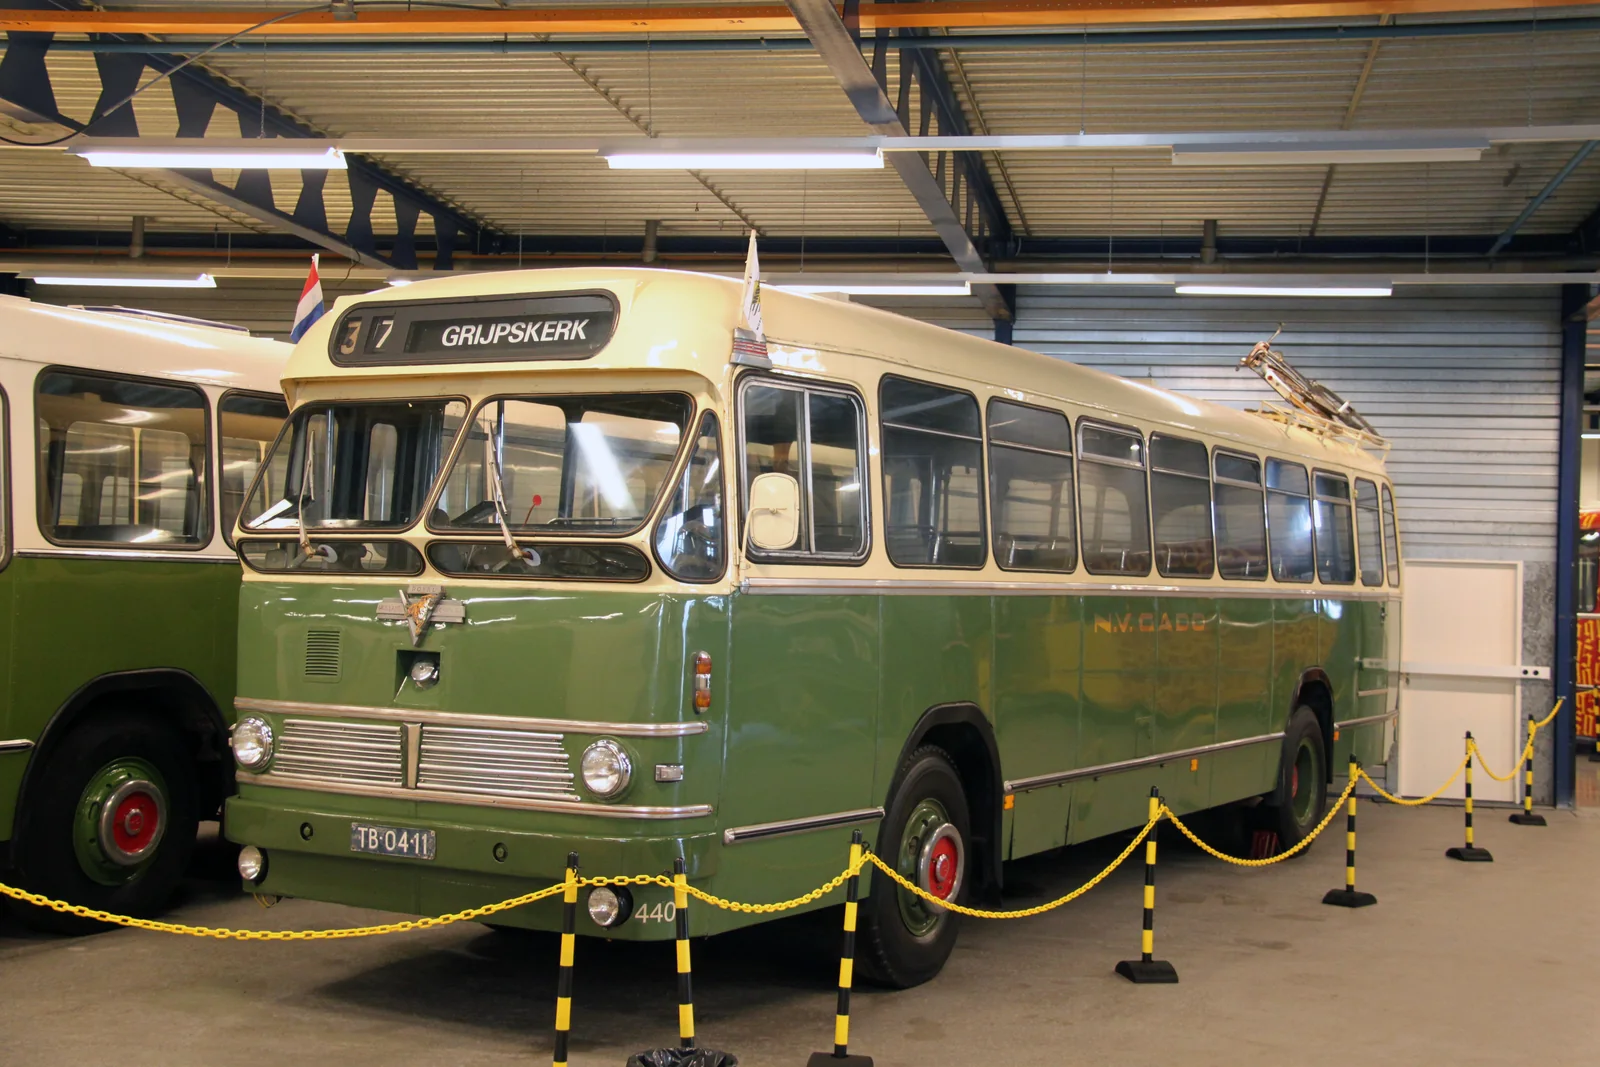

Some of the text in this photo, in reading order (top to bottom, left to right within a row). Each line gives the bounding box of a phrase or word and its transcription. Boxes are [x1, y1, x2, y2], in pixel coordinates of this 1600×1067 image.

[441, 318, 590, 347] GRIJPSKERK
[1094, 612, 1133, 633] N.V.
[634, 901, 676, 924] 440
